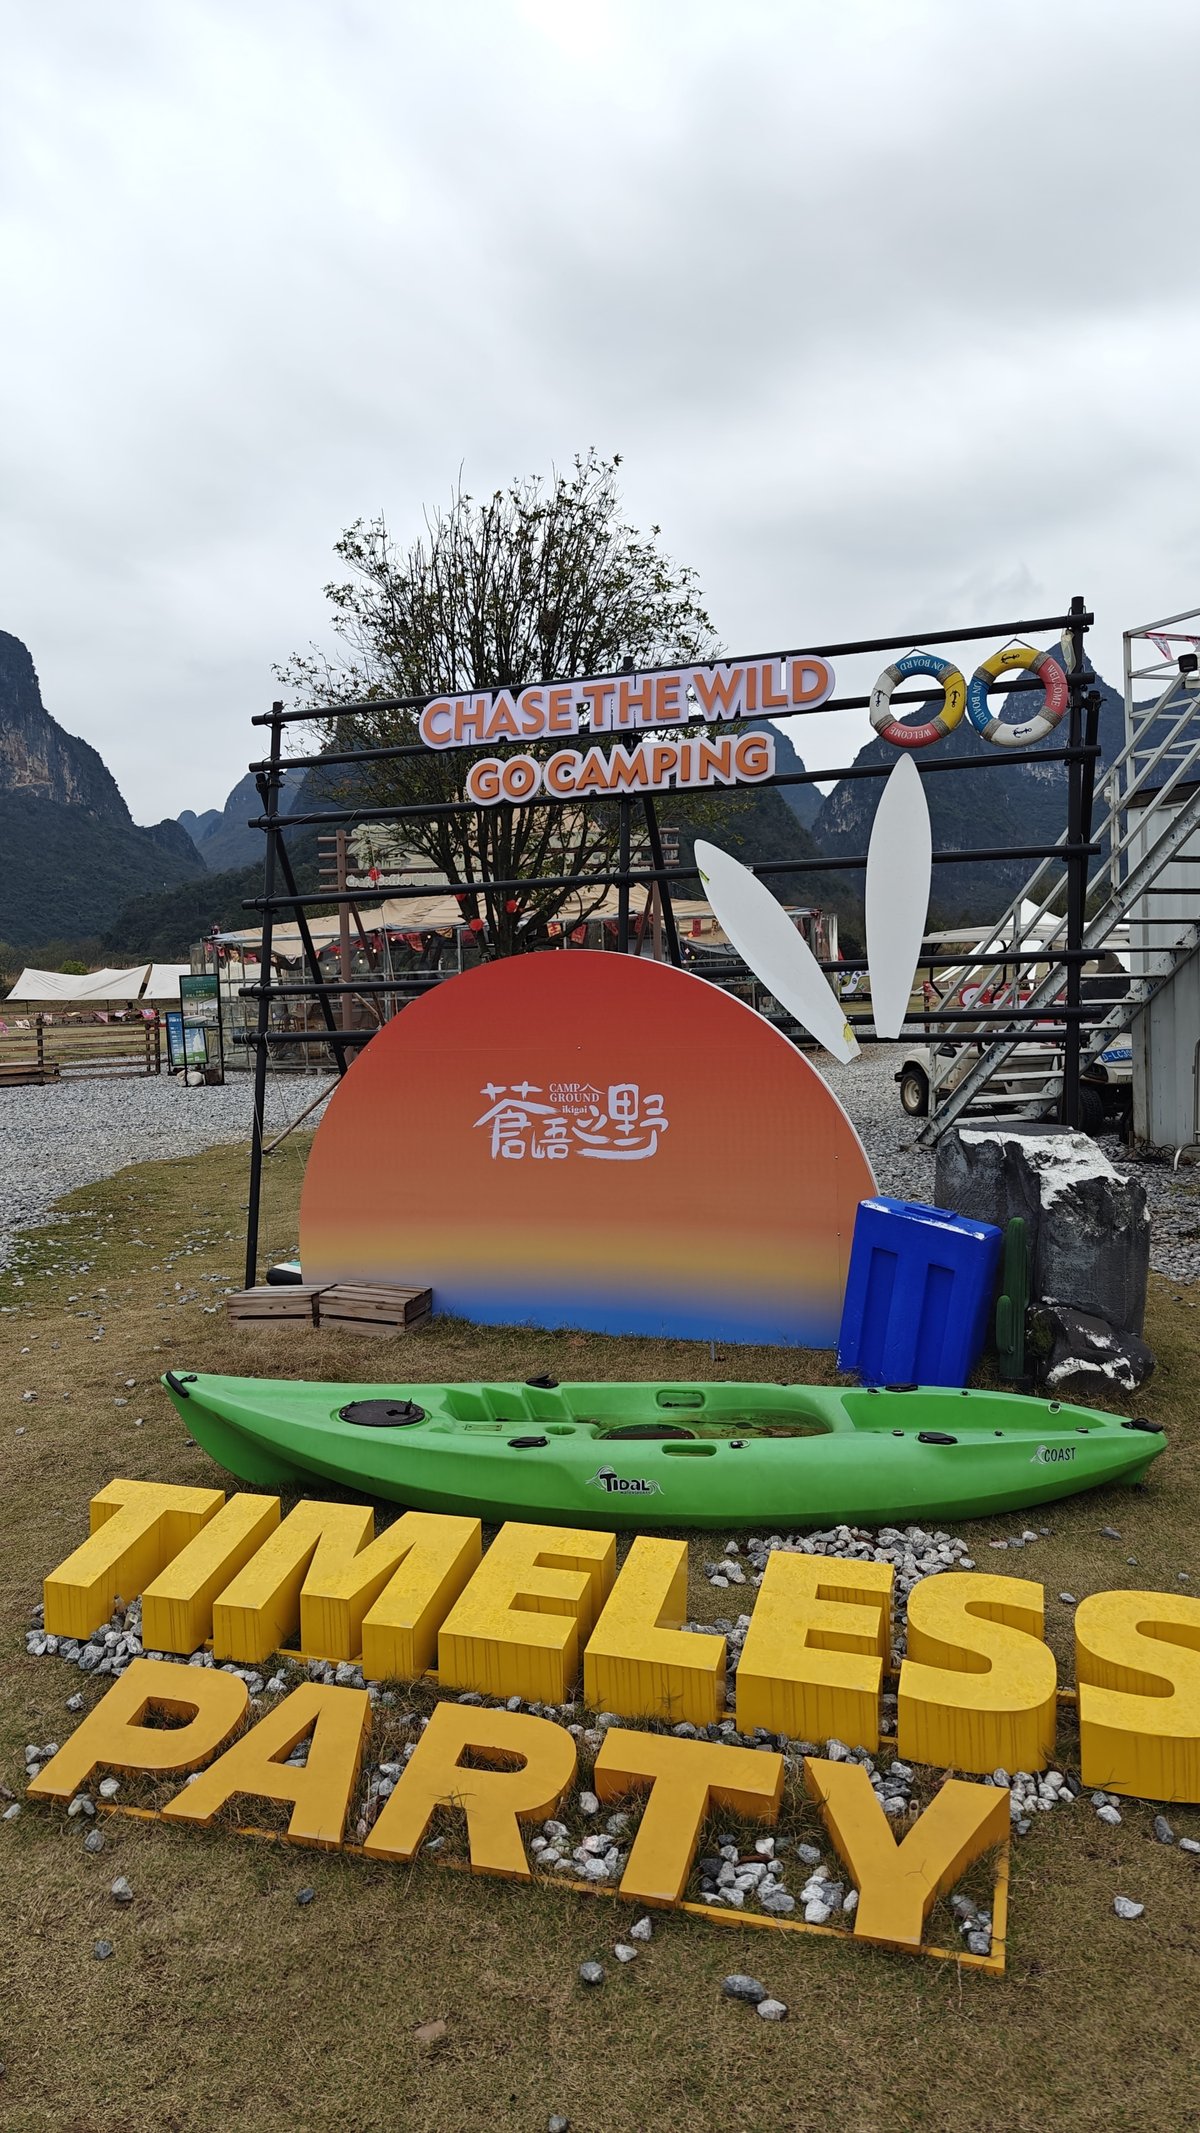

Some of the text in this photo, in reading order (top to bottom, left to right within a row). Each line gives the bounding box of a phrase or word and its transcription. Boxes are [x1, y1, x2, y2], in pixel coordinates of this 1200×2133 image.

[900, 658, 945, 671] ON BOARD
[1047, 664, 1063, 707] WELCOME
[421, 659, 829, 745] CHASE THE WILD
[971, 681, 989, 725] ON BOARD
[889, 726, 932, 739] WELCOME
[469, 737, 770, 800] GO CAMPING
[550, 1083, 580, 1092] CAMP
[550, 1092, 600, 1102] GROUND
[562, 1105, 588, 1115] ikigai
[1044, 1447, 1076, 1463] COAST
[44, 1478, 1200, 1803] TIMELESS
[27, 1658, 1011, 1947] PARTY
